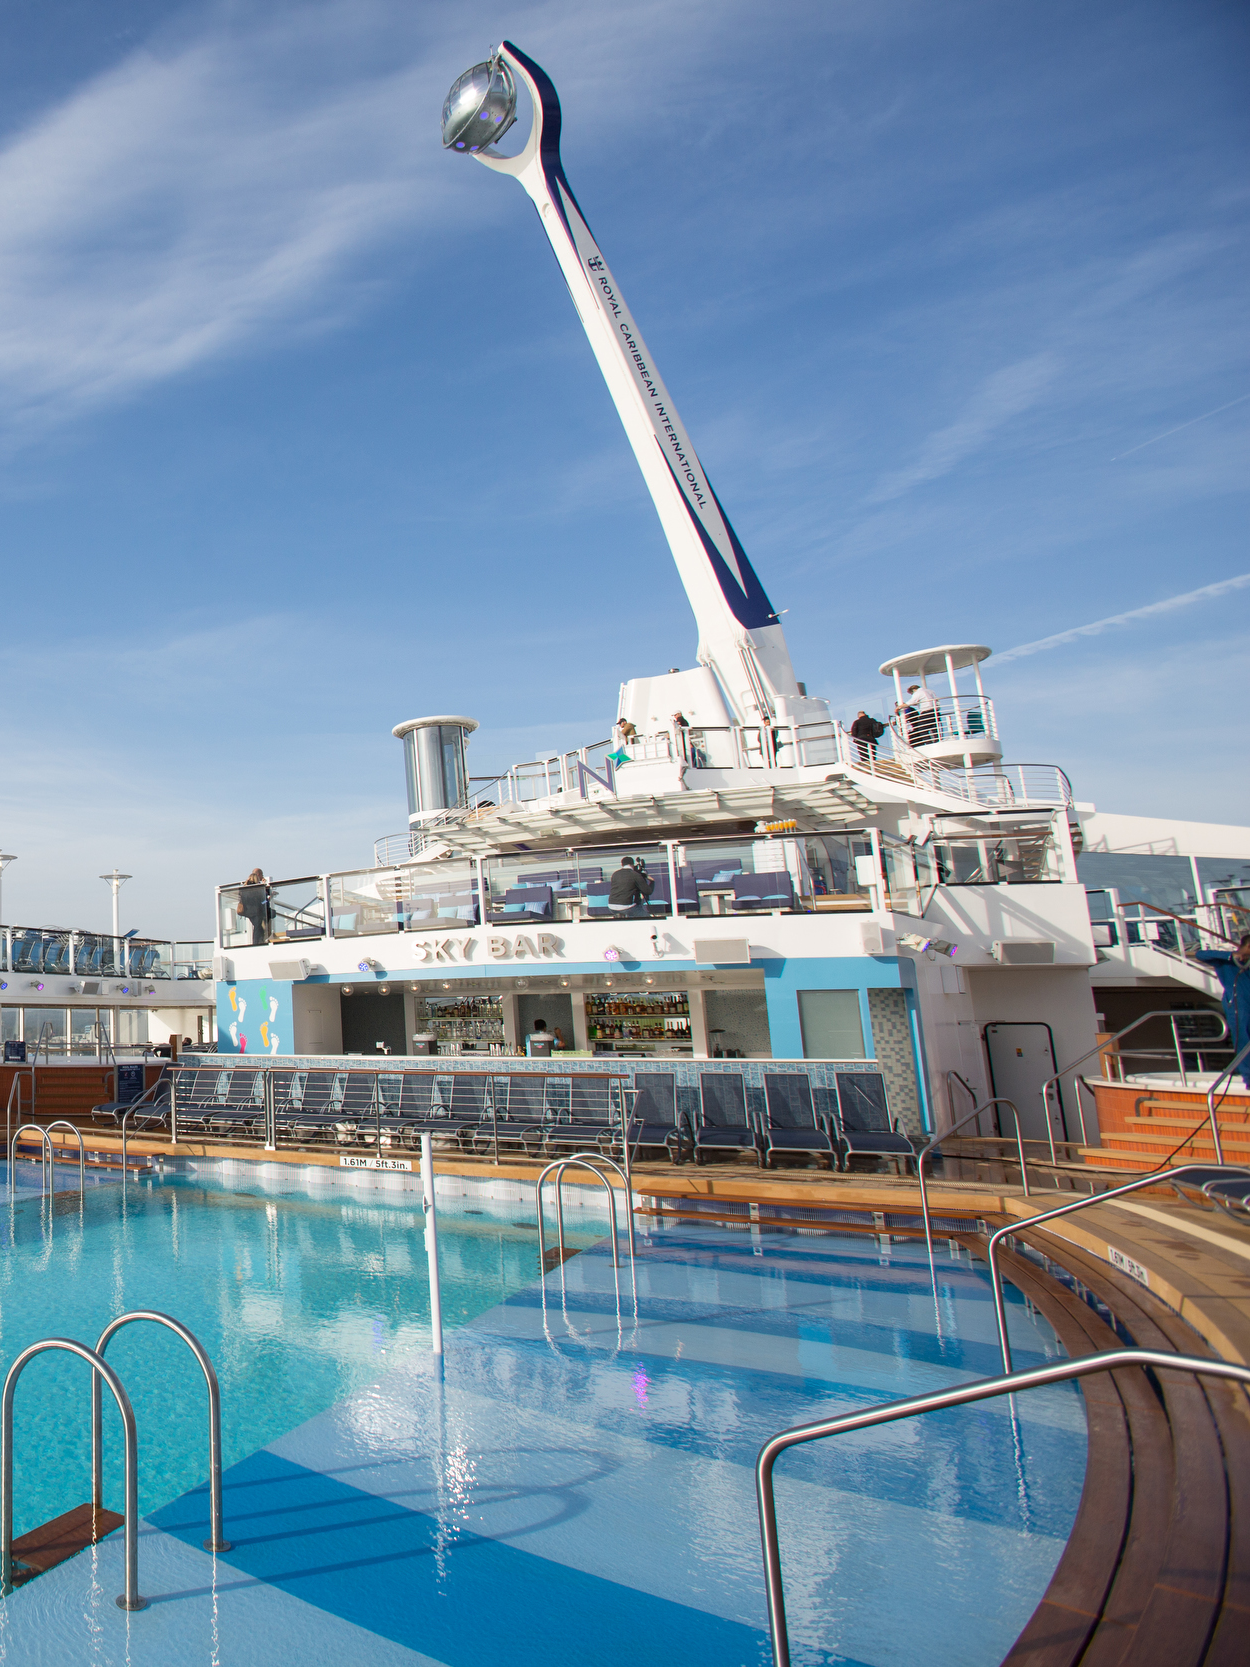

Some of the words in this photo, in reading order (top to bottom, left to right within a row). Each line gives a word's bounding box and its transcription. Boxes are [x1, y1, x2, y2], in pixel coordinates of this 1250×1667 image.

[598, 276, 621, 319] ROYAL
[619, 323, 658, 398] CARIBBEAN
[654, 402, 707, 510] INTERNATIONAL
[412, 937, 476, 962] SKY
[486, 932, 564, 958] BAR
[343, 1157, 367, 1167] 1.61M
[369, 1159, 374, 1167] /
[375, 1159, 408, 1170] 5ft.3in.
